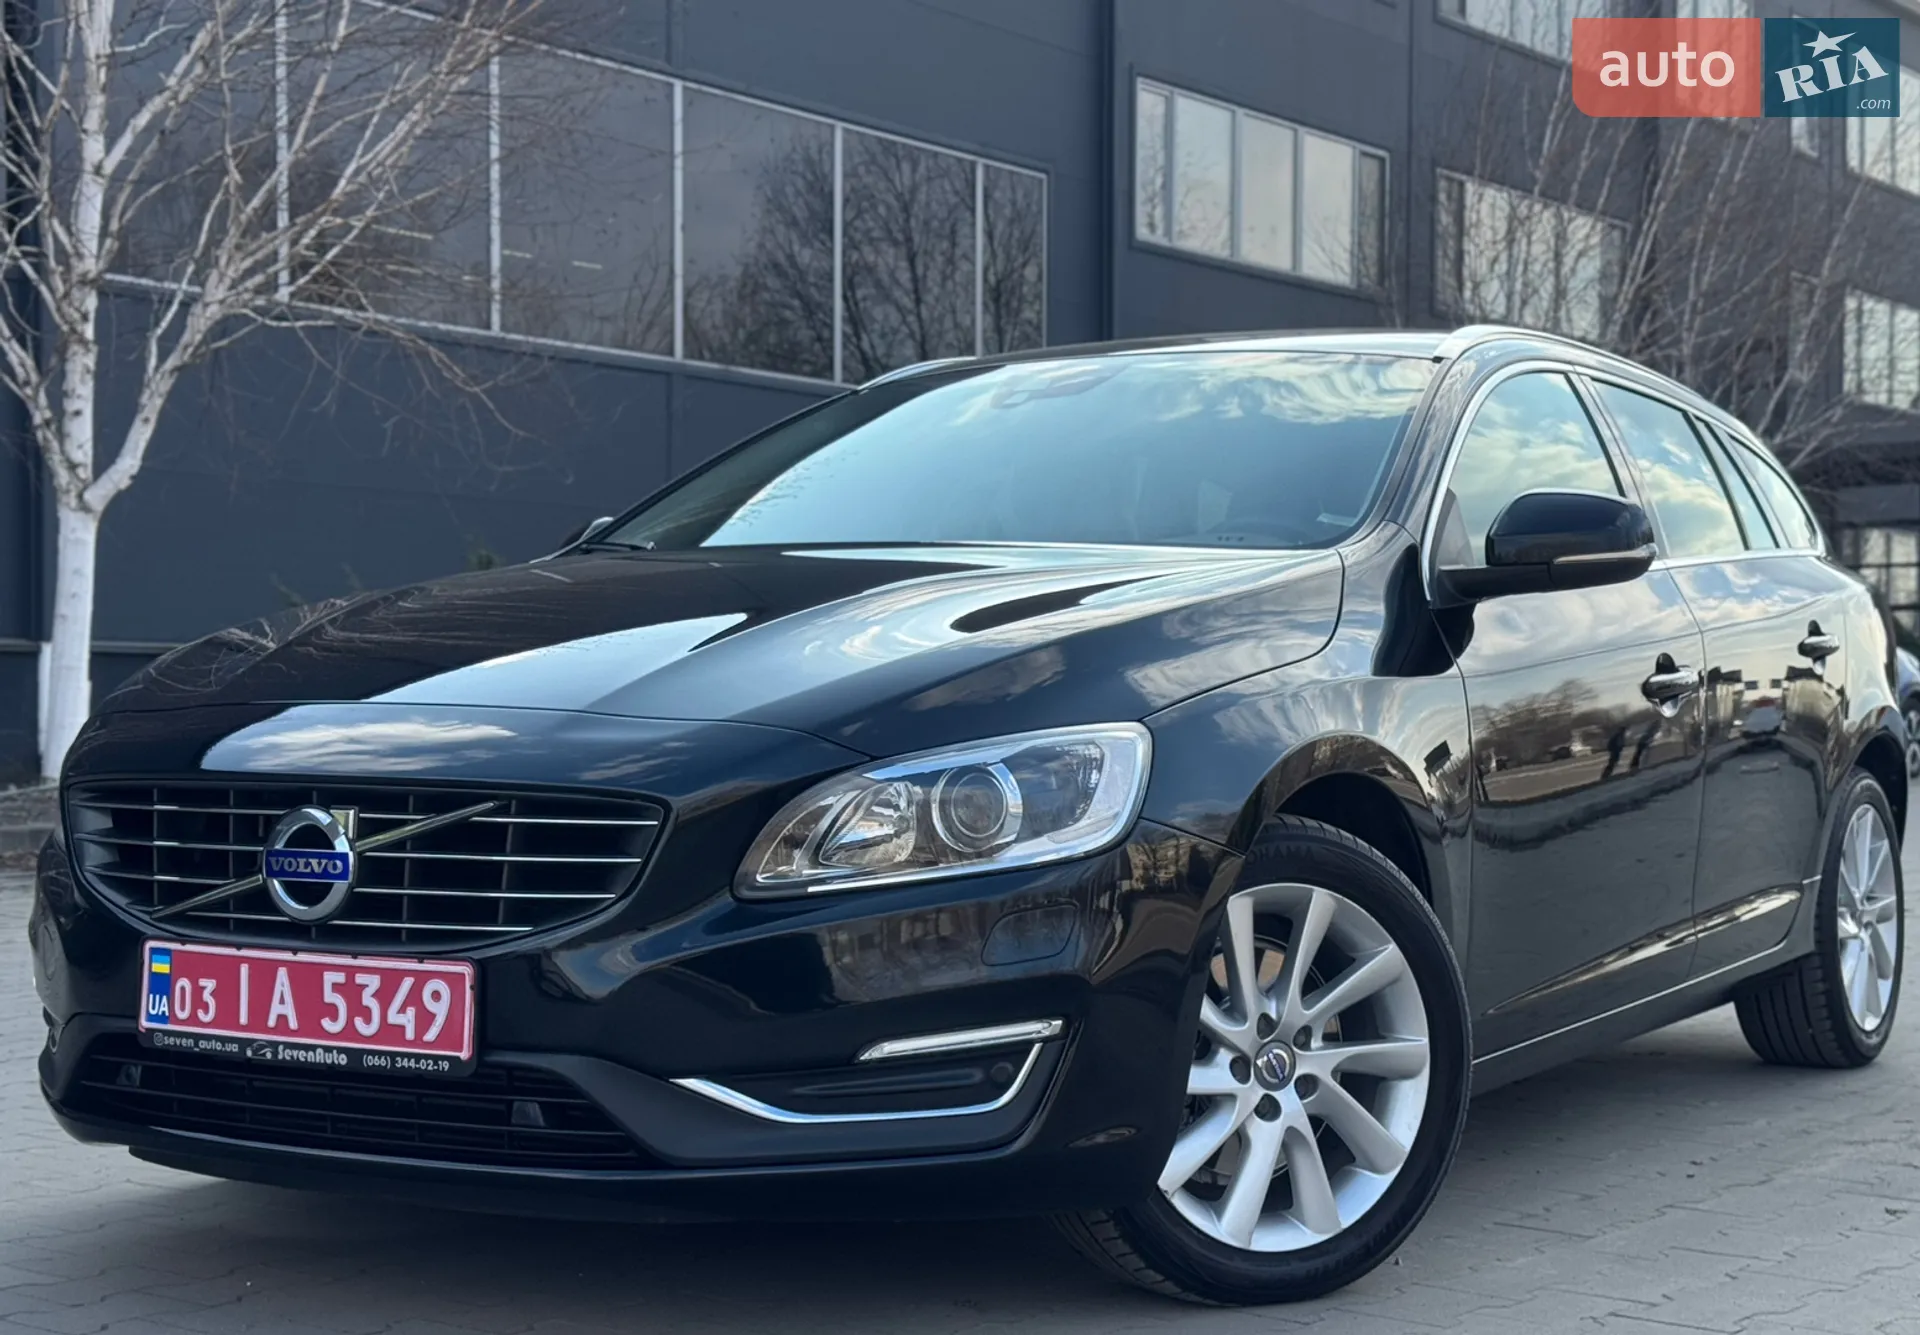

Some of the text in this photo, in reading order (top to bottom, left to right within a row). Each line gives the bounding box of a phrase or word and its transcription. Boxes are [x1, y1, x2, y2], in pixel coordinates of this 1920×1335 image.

[268, 856, 344, 874] VOLVO
[148, 994, 169, 1016] UA
[174, 977, 217, 1024] 03
[320, 971, 451, 1043] 5349
[277, 1044, 348, 1066] SevenAuto
[362, 1054, 450, 1073] (066) 344-02-19
